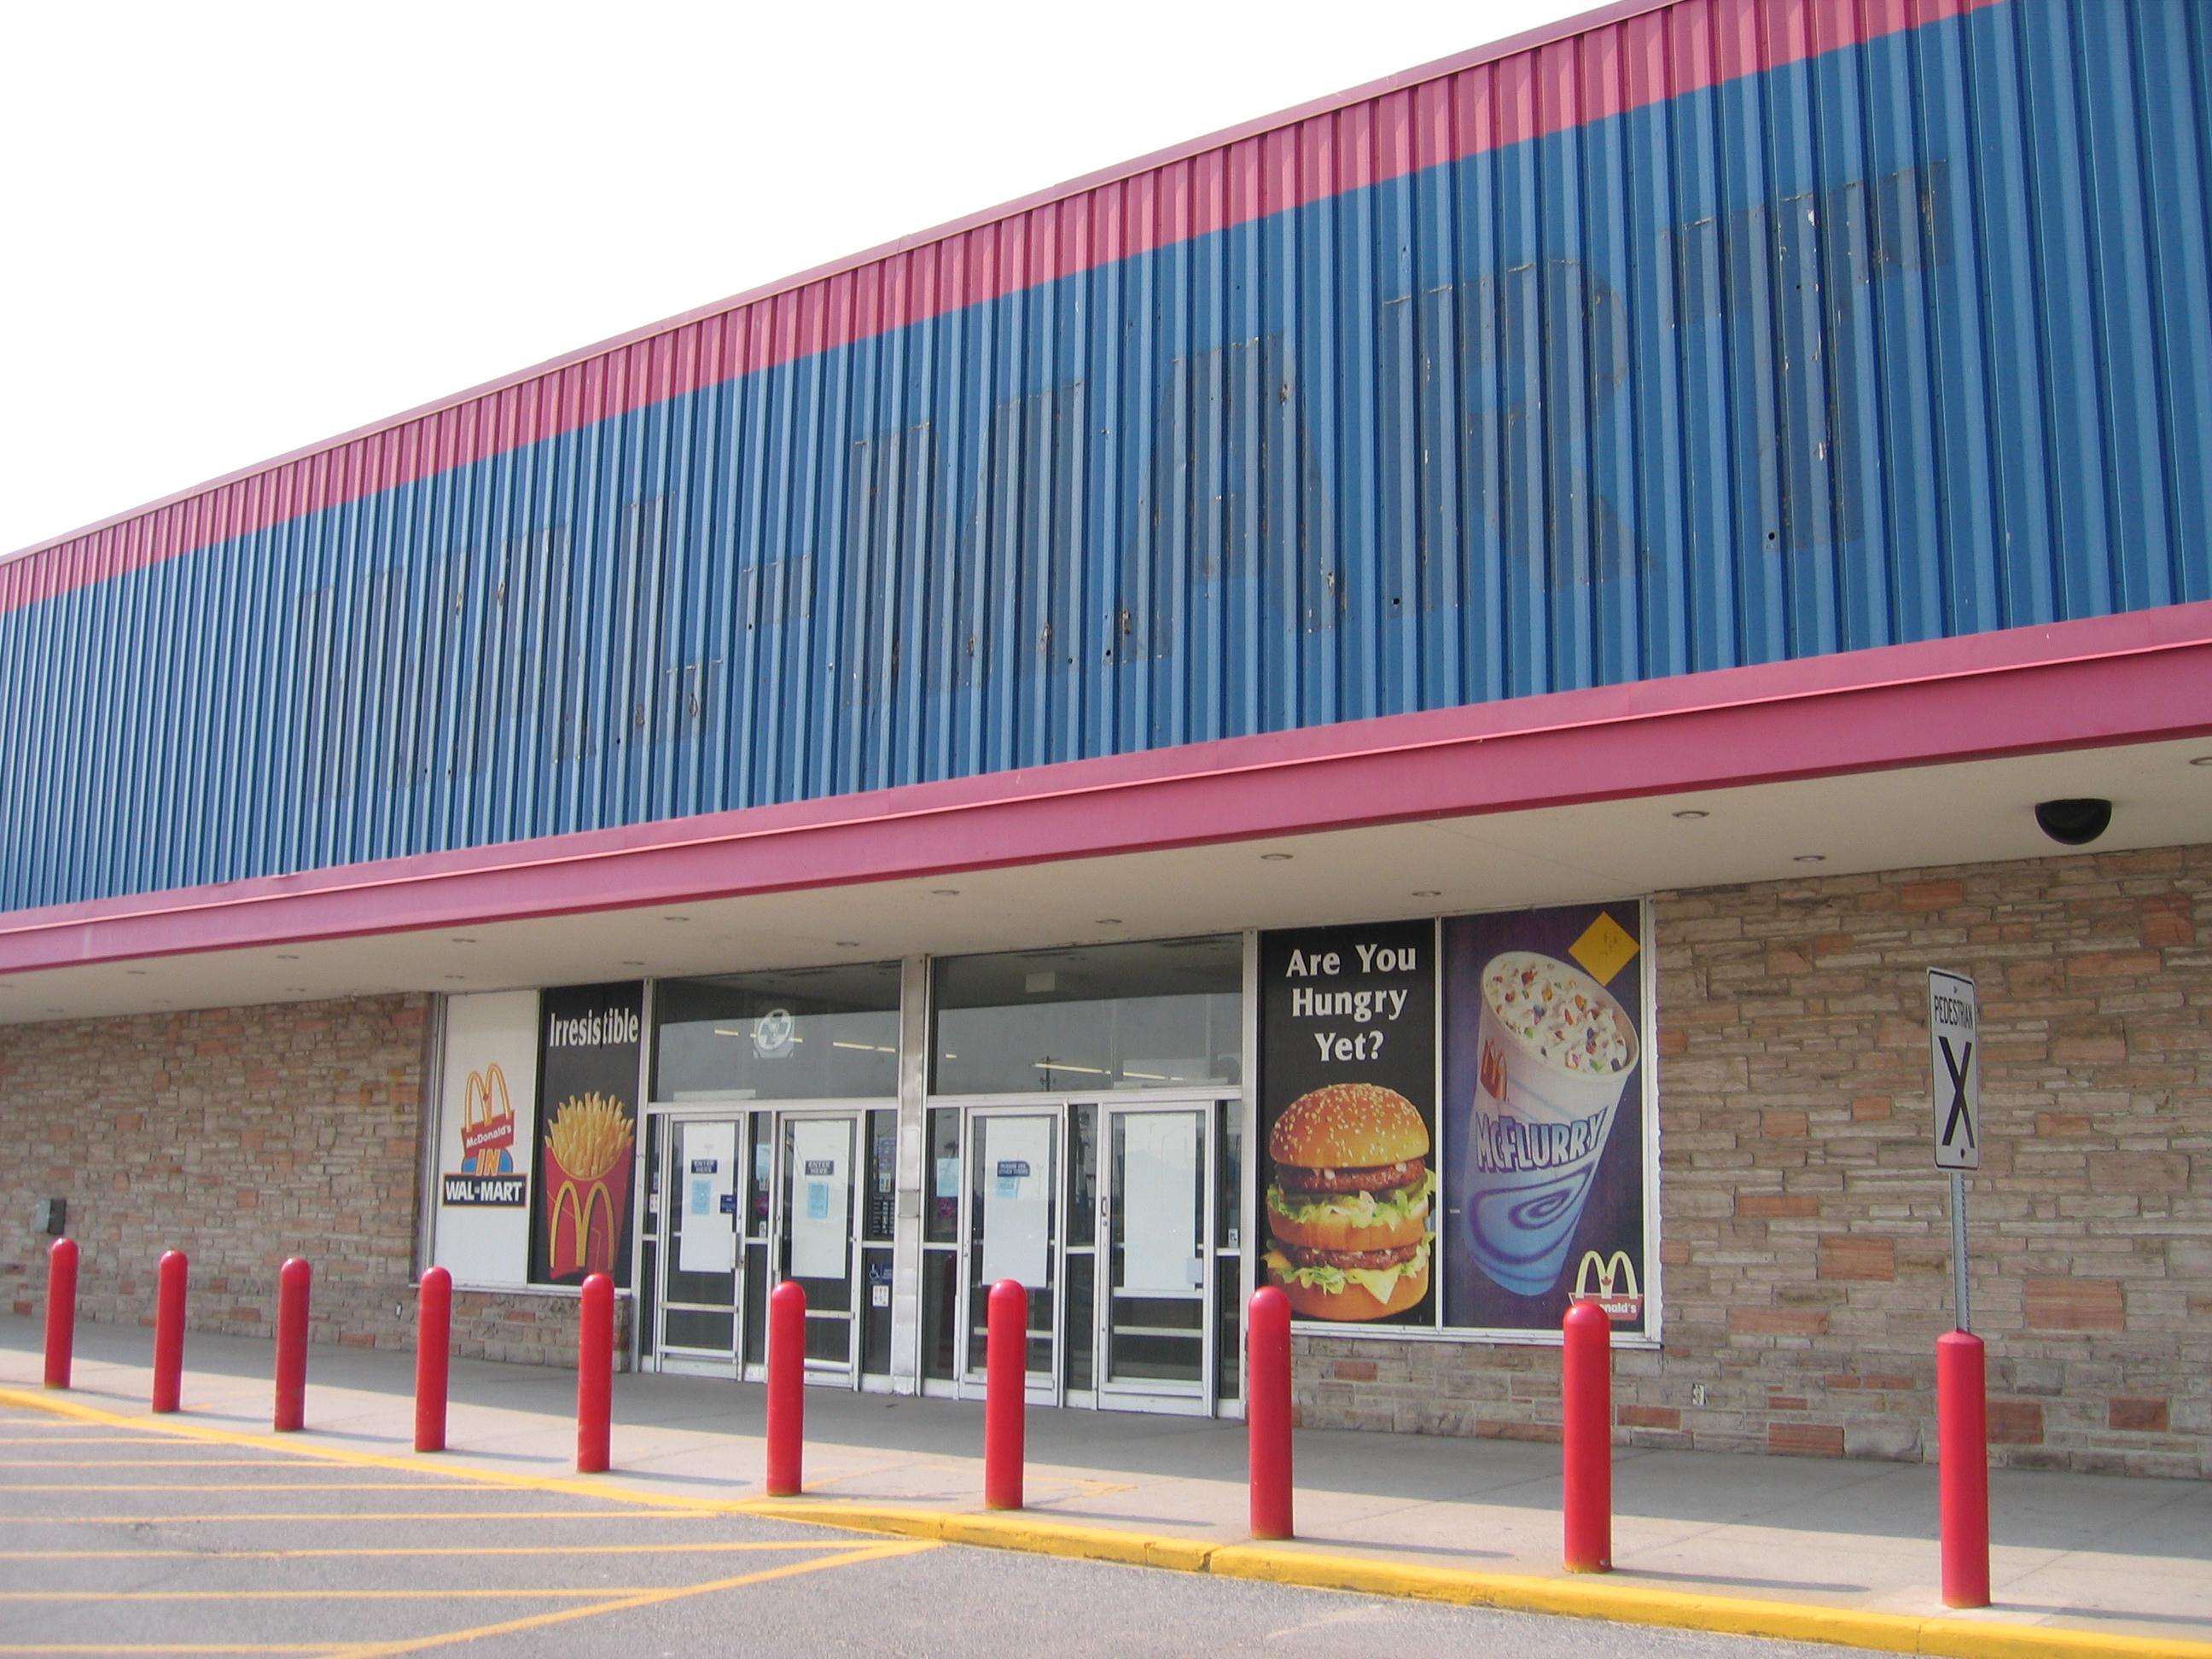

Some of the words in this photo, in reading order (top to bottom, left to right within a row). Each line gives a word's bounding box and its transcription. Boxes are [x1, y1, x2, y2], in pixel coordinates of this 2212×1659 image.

[1286, 949, 1341, 977] Are
[1355, 943, 1417, 973] You
[1291, 987, 1408, 1022] Hungry
[1934, 995, 1974, 1029] PEDESTRIAN
[549, 1007, 640, 1048] Irresistible
[1314, 1030, 1385, 1062] Yet?
[466, 1125, 512, 1149] McDonald's
[475, 1148, 502, 1177] IN
[1603, 1302, 1637, 1313] nald's
